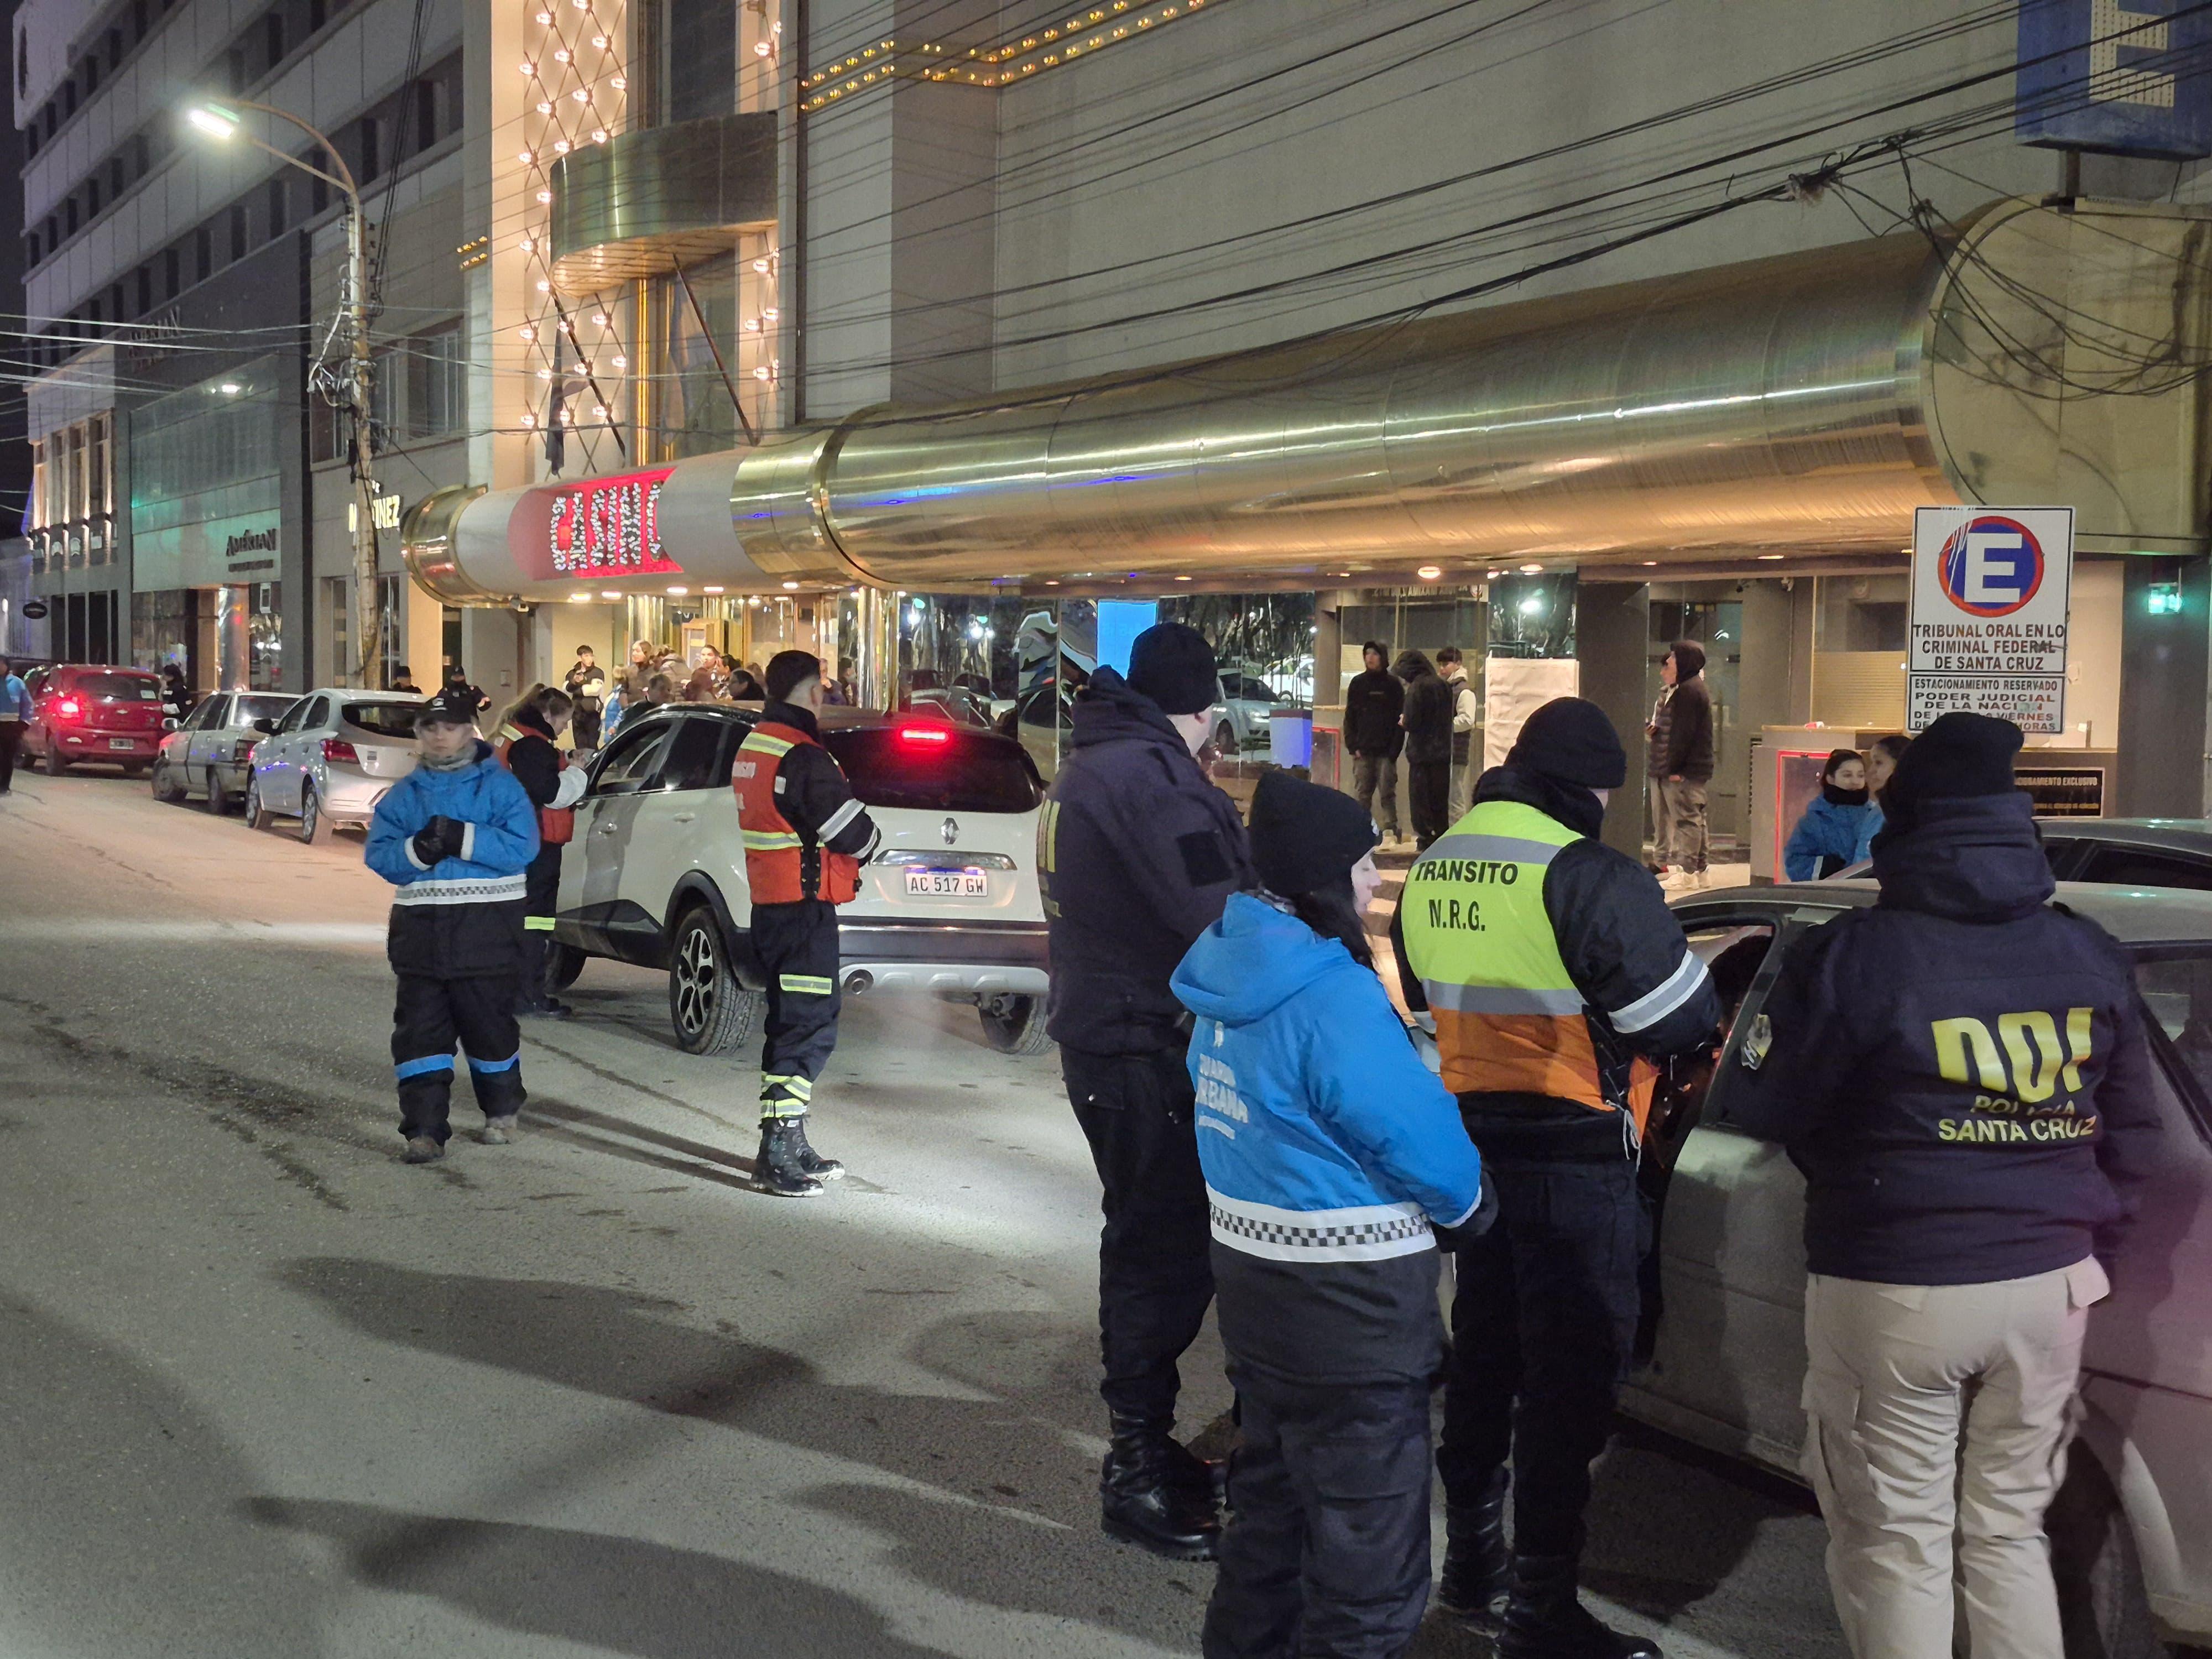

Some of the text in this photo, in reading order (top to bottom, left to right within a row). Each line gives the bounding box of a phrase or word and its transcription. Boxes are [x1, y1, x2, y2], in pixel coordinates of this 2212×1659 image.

[1964, 533, 2022, 603] E
[1913, 624, 2064, 638] TRIBUNAL ORAL EN LO
[1922, 640, 2056, 654] CRIMINAL FEDERAL
[1935, 656, 2044, 670] DE SANTA CRUZ
[1914, 679, 2057, 691] ESTACIONAMIENTO RESERVADO
[1915, 692, 2056, 702] PODER JUDICIAL
[1924, 701, 2043, 711] DE LA NACI
[1914, 711, 1931, 719] DE
[2063, 777, 2098, 786] EXCLUSIVO
[1415, 860, 1518, 885] TRANSITO
[911, 877, 983, 893] AC 517 GW
[1428, 899, 1485, 931] N.R.G.
[1939, 1115, 2098, 1142] SANTA CRUZ
